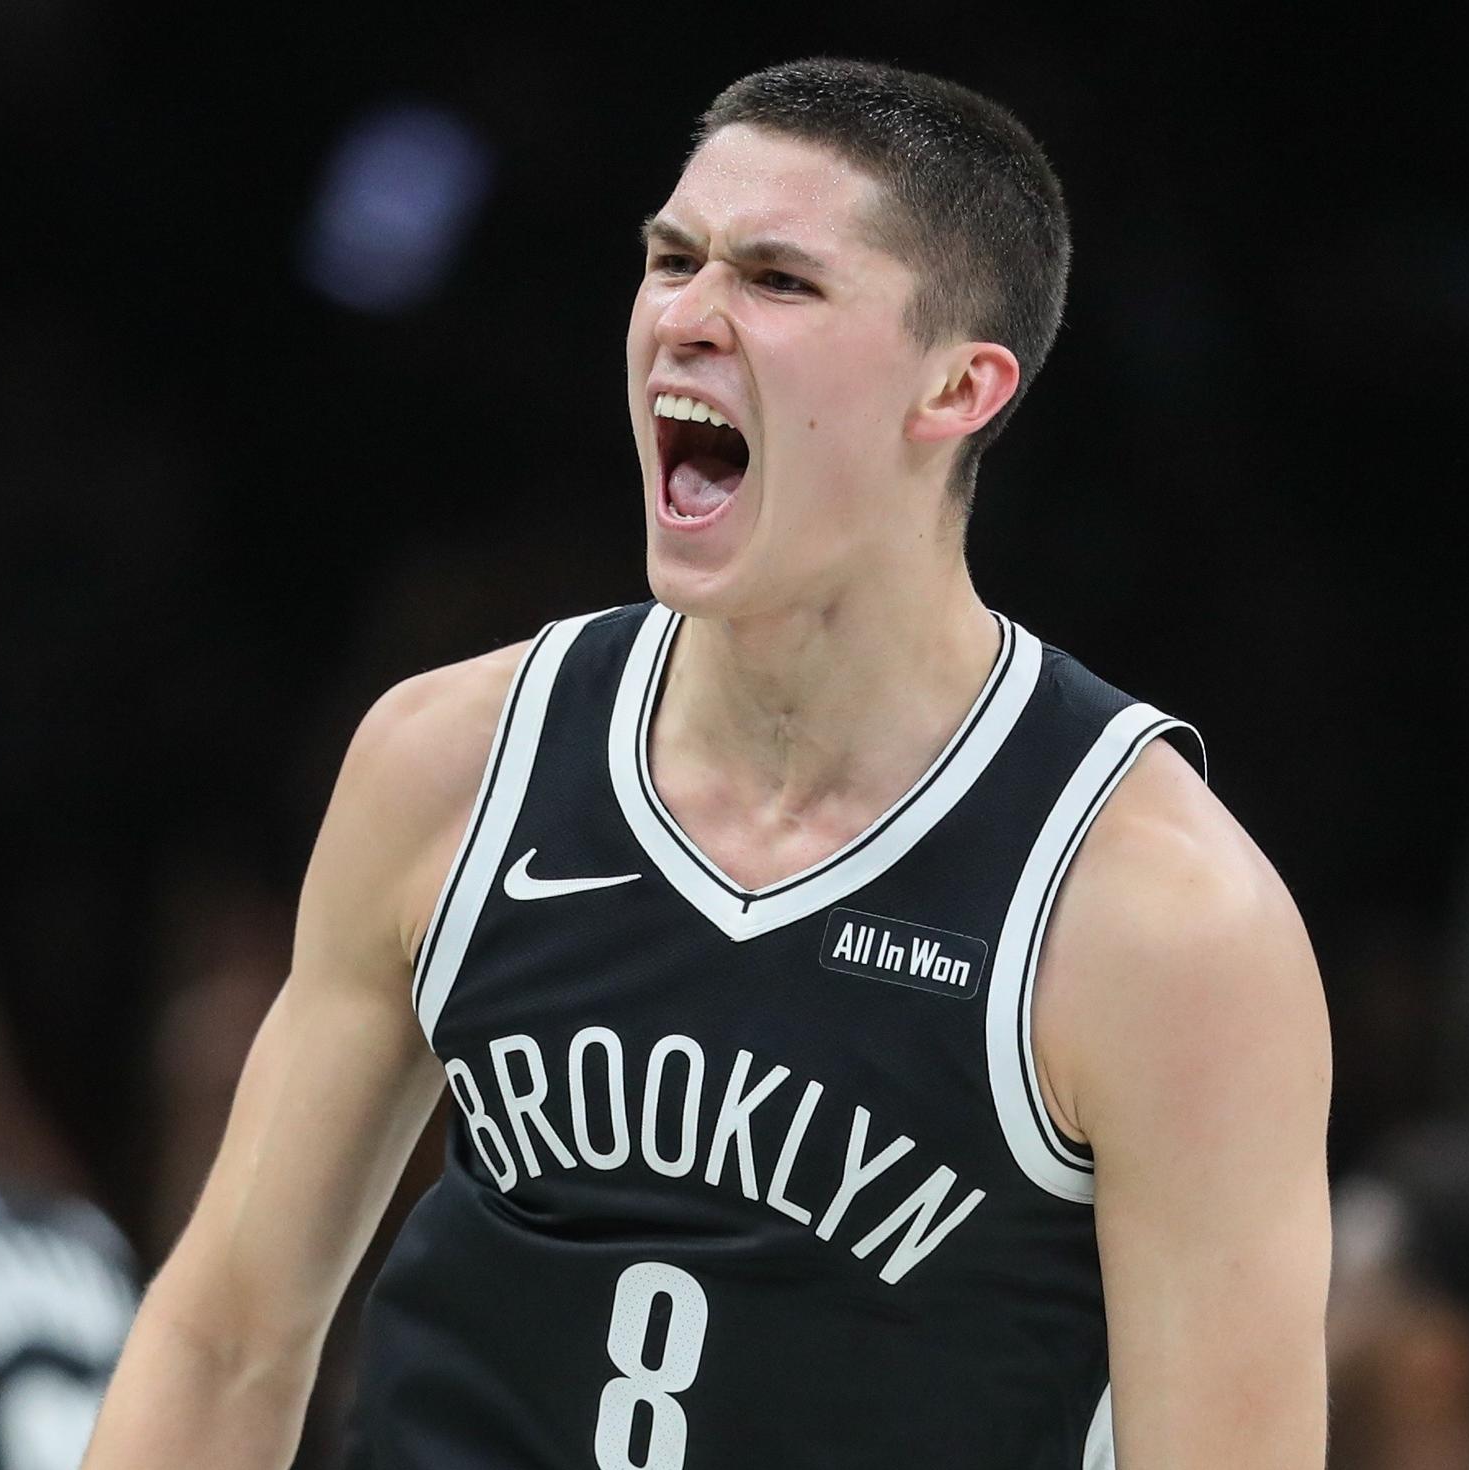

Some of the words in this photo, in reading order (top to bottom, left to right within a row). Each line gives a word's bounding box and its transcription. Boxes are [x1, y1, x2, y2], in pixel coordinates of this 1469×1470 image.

[832, 922, 876, 965] All
[876, 931, 905, 972] In
[909, 937, 971, 987] Won
[444, 1026, 986, 1286] BROOKLYN
